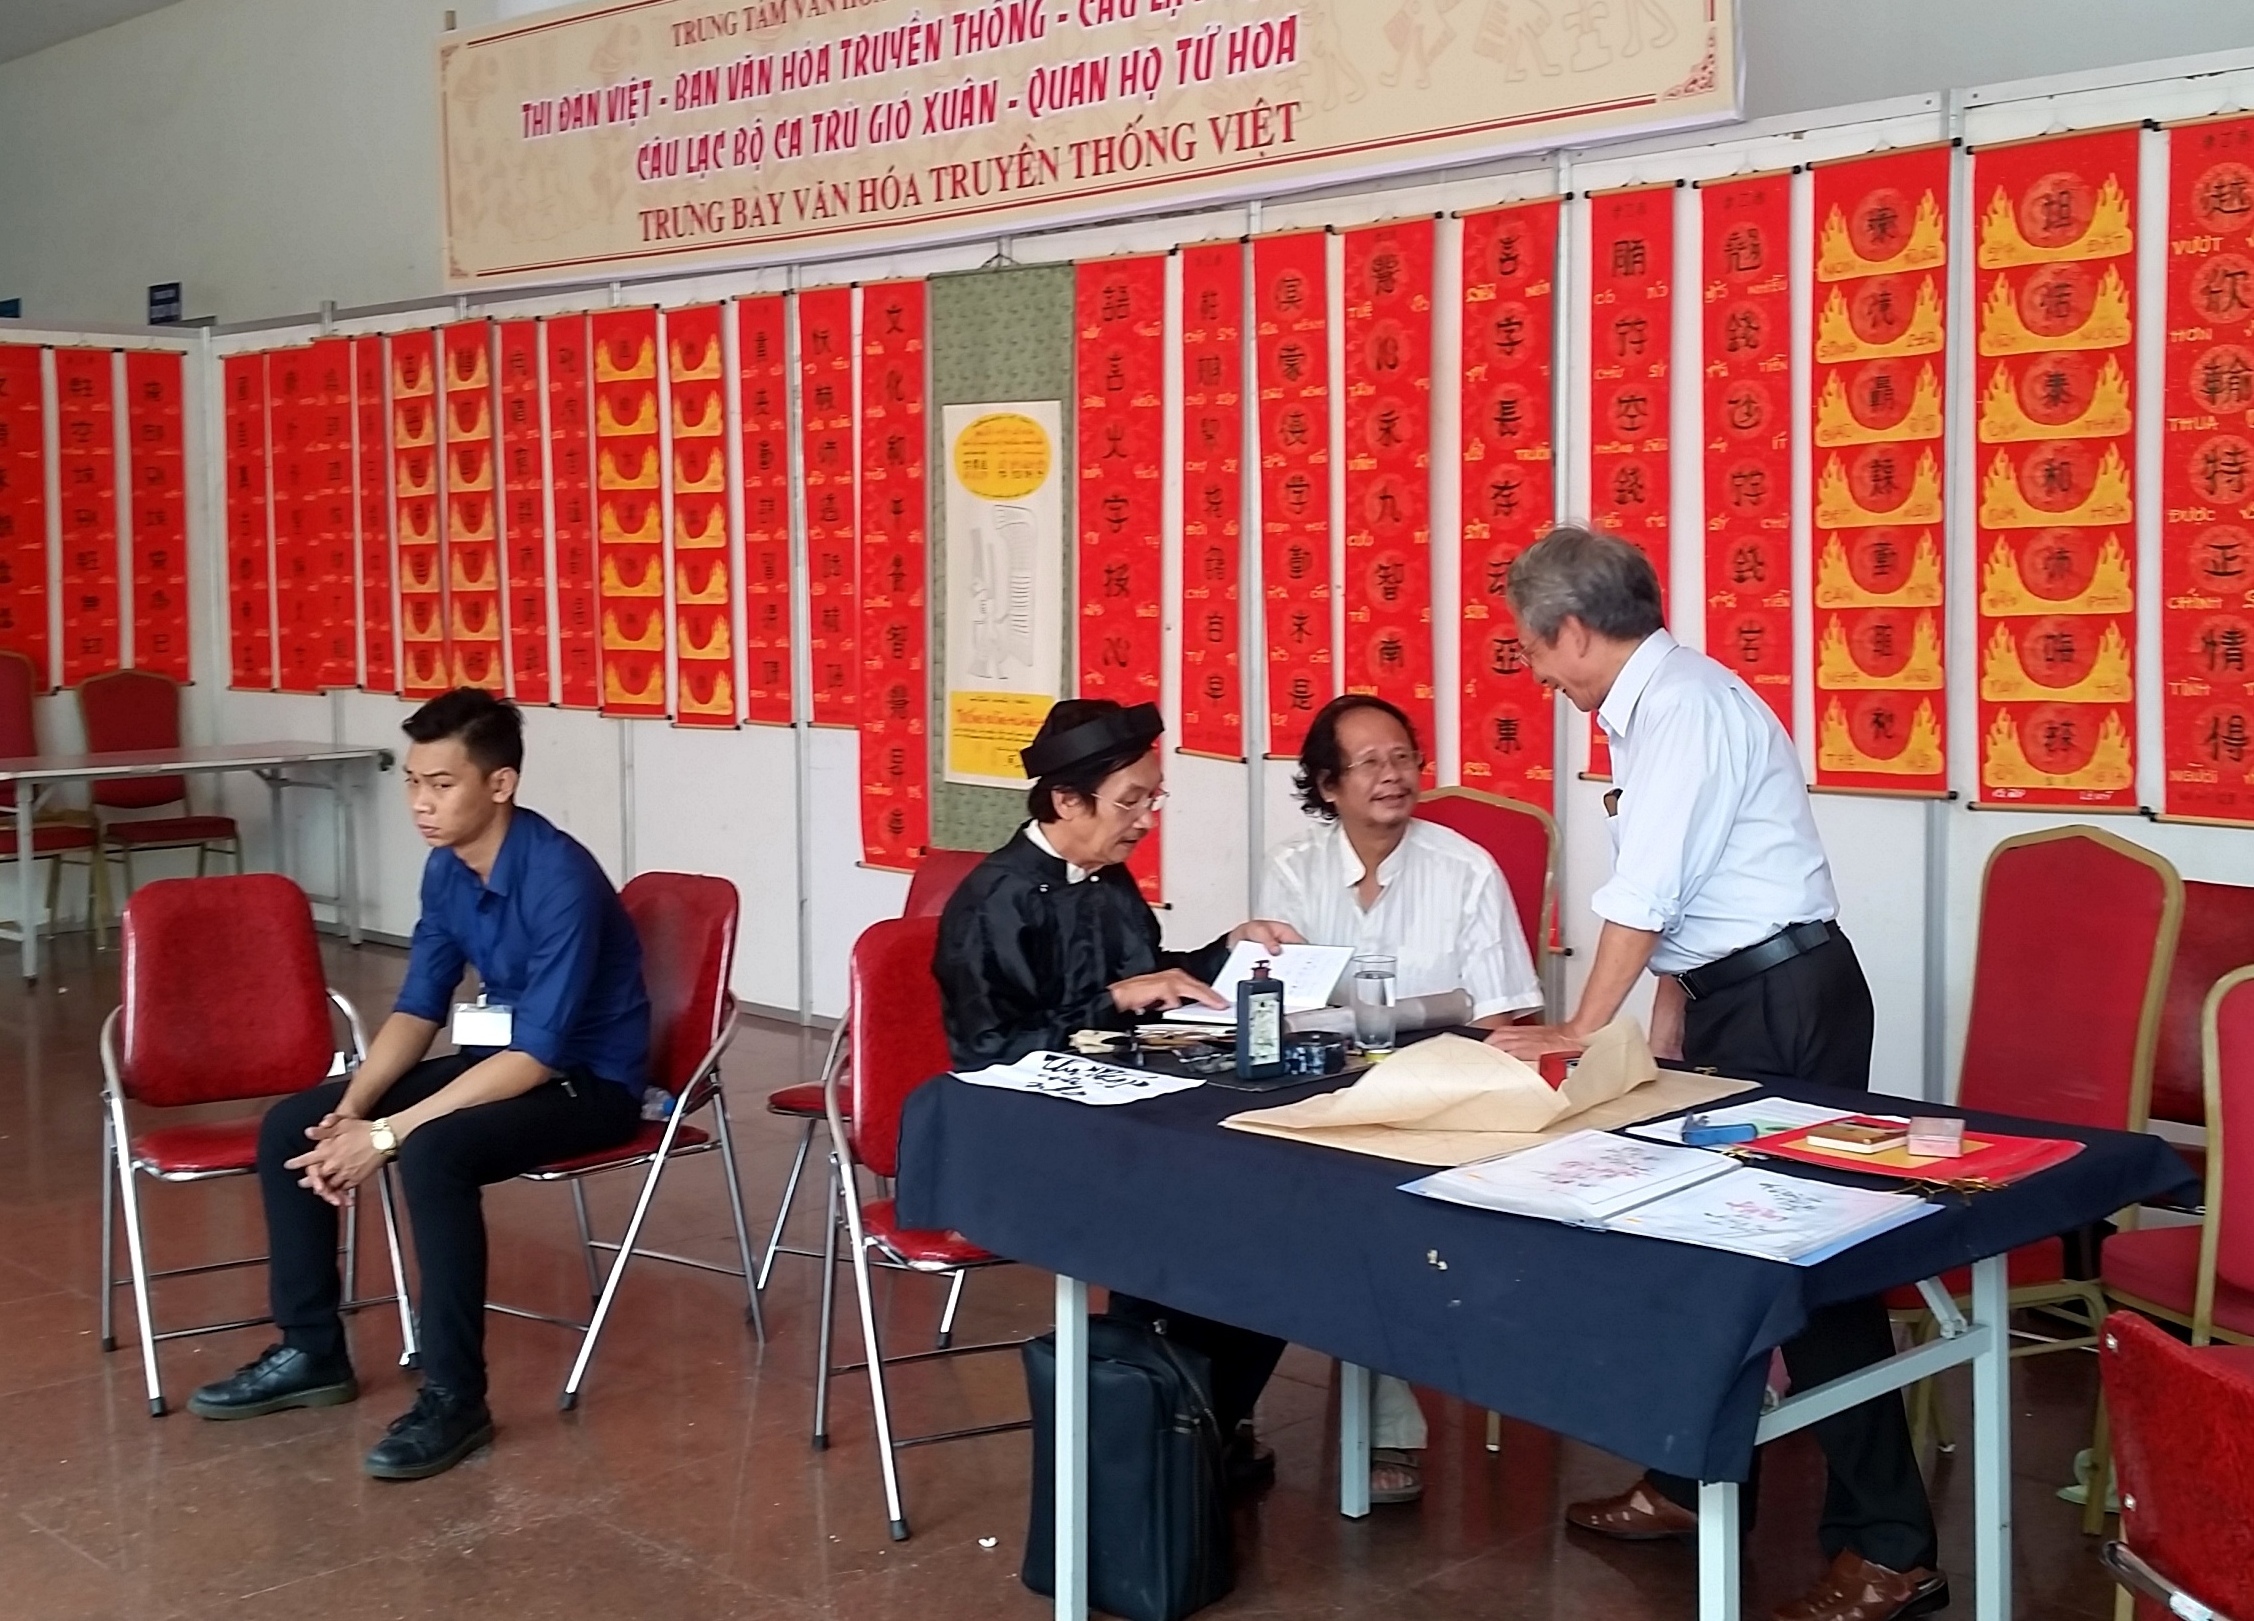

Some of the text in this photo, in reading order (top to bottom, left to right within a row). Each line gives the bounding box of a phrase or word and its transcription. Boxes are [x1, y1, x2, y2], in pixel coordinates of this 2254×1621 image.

[672, 10, 738, 47] TRUNG
[521, 101, 552, 139] THI
[607, 77, 652, 127] VIỆT
[675, 67, 720, 111] BAN
[637, 136, 681, 181] CÂU
[687, 130, 727, 178] LẠC
[733, 118, 764, 171] BỘ
[774, 117, 801, 159] CA
[922, 78, 998, 135] XUÂN
[1028, 58, 1109, 118] QUAN
[1120, 47, 1162, 100] HỌ
[1227, 14, 1298, 75] HOA
[731, 186, 785, 230] BÀY
[792, 181, 851, 220] VĂN
[858, 165, 923, 213] HÓA
[928, 133, 1060, 203] TRUYỀN
[1069, 114, 1197, 179] THỐNG
[1208, 97, 1302, 157] VIỆT
